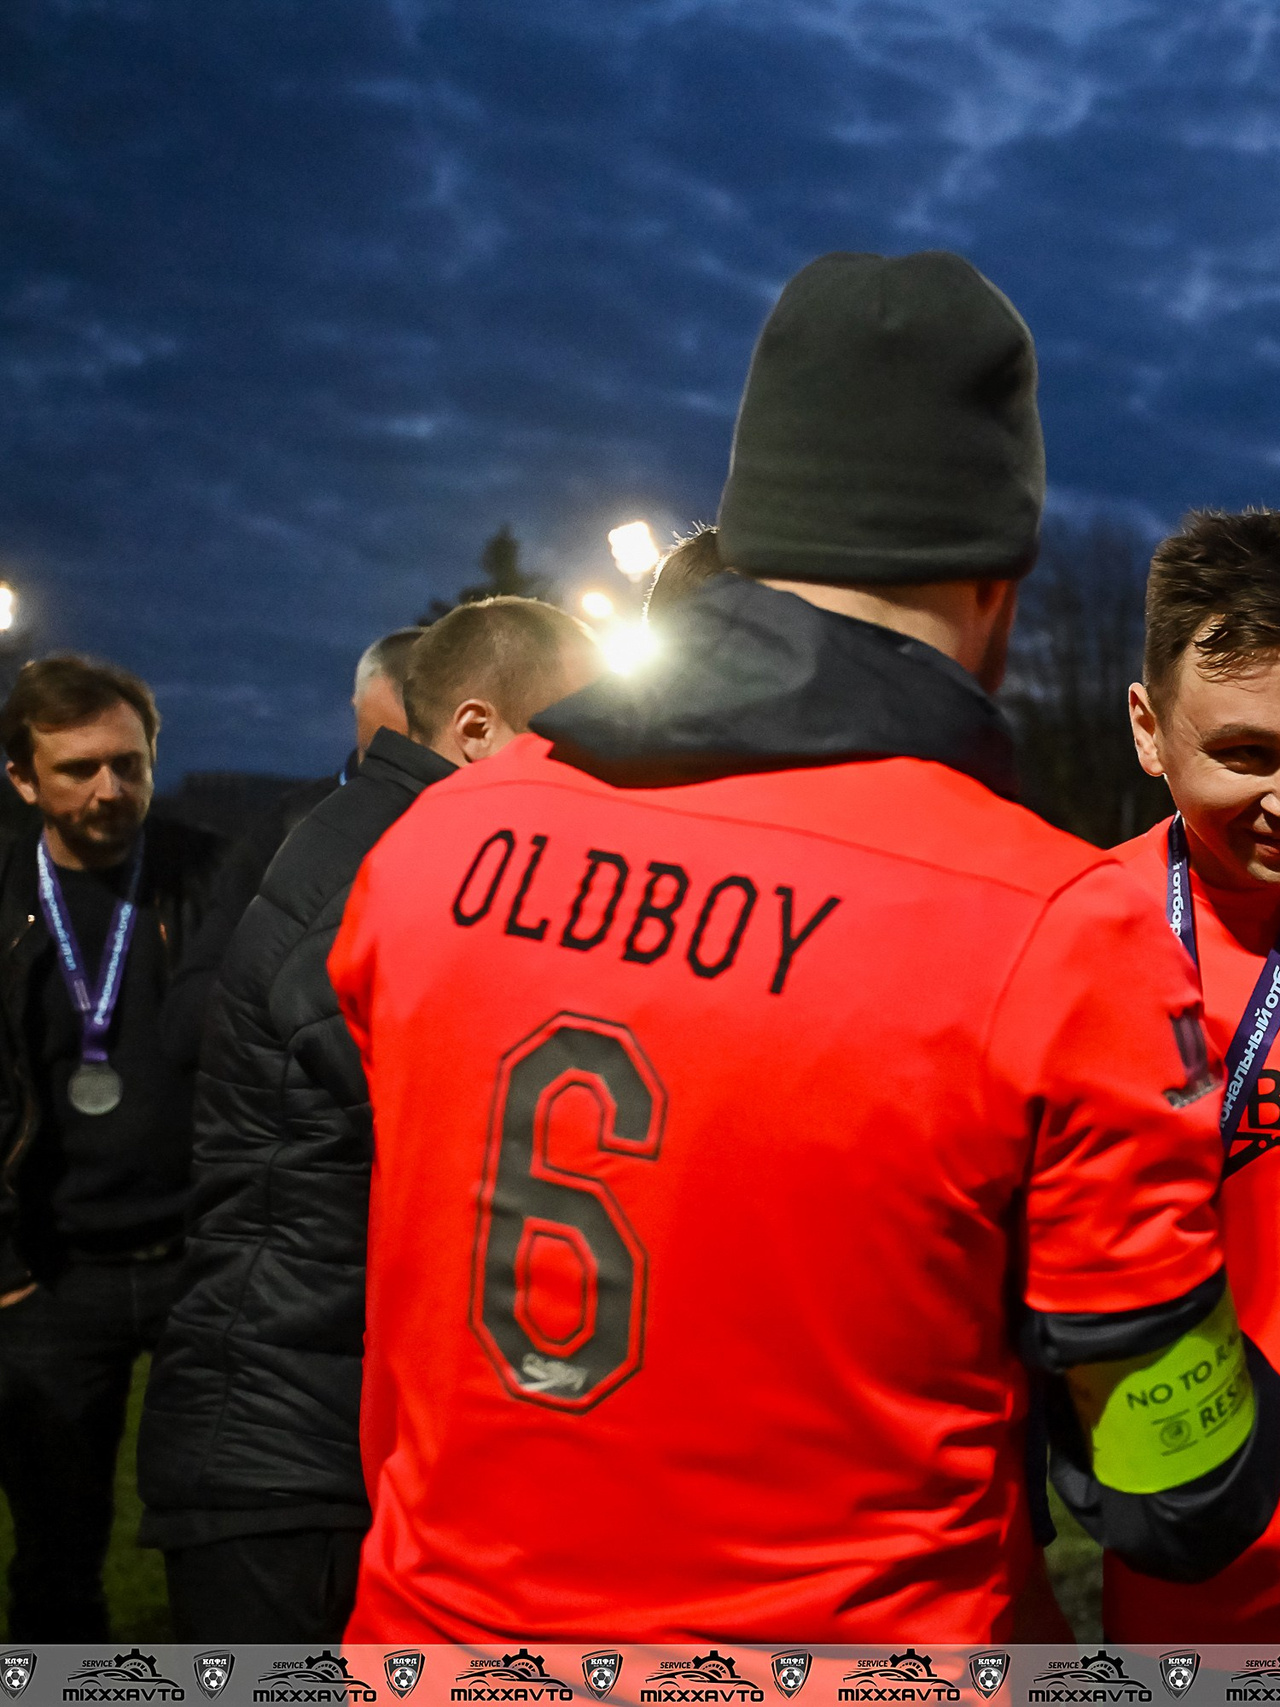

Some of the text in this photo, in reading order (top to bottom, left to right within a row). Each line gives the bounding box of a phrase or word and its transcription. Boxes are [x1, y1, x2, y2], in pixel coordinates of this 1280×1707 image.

[451, 829, 843, 995] OLDBOY
[1169, 871, 1184, 947] отбор
[1220, 1008, 1273, 1129] ональный
[468, 1010, 669, 1416] 6
[1126, 1384, 1173, 1410] NO
[1179, 1361, 1213, 1391] TO
